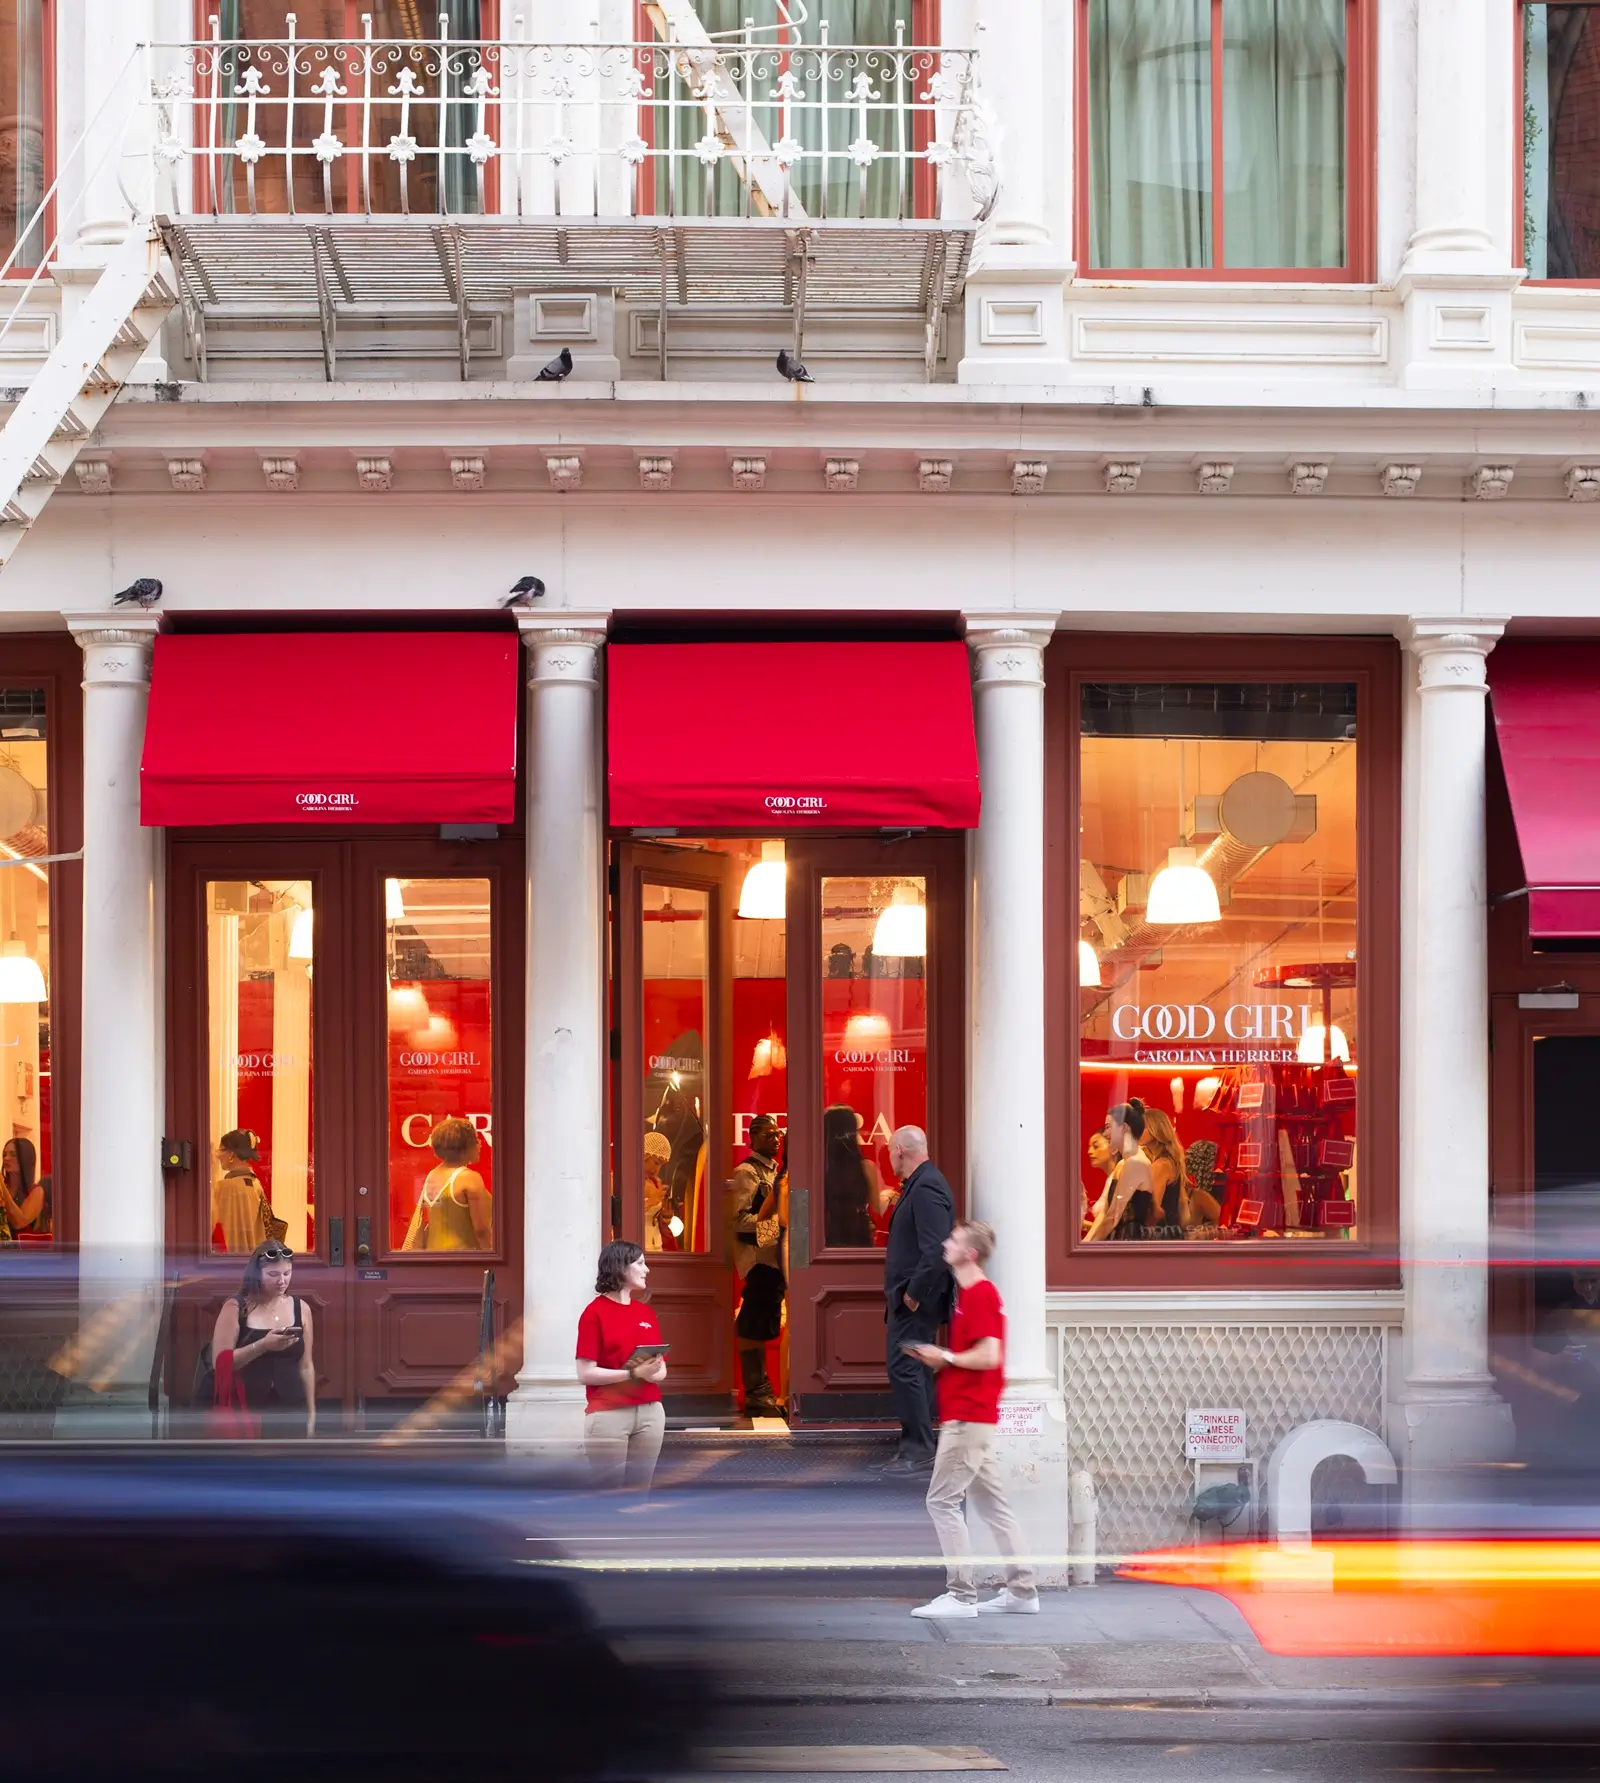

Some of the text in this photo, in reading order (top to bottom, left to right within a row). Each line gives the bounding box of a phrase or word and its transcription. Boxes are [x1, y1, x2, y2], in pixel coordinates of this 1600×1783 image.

[295, 793, 360, 805] GOOD GIRL
[764, 796, 828, 808] GOOD GIRL
[1112, 1004, 1216, 1039] GOOD
[400, 1052, 481, 1066] GOOD GIRL
[835, 1049, 916, 1064] GOOD GIRL
[1134, 1050, 1216, 1062] CAROLINA
[1196, 1415, 1240, 1424] PRINKLER
[1189, 1435, 1243, 1444] CONNECTION
